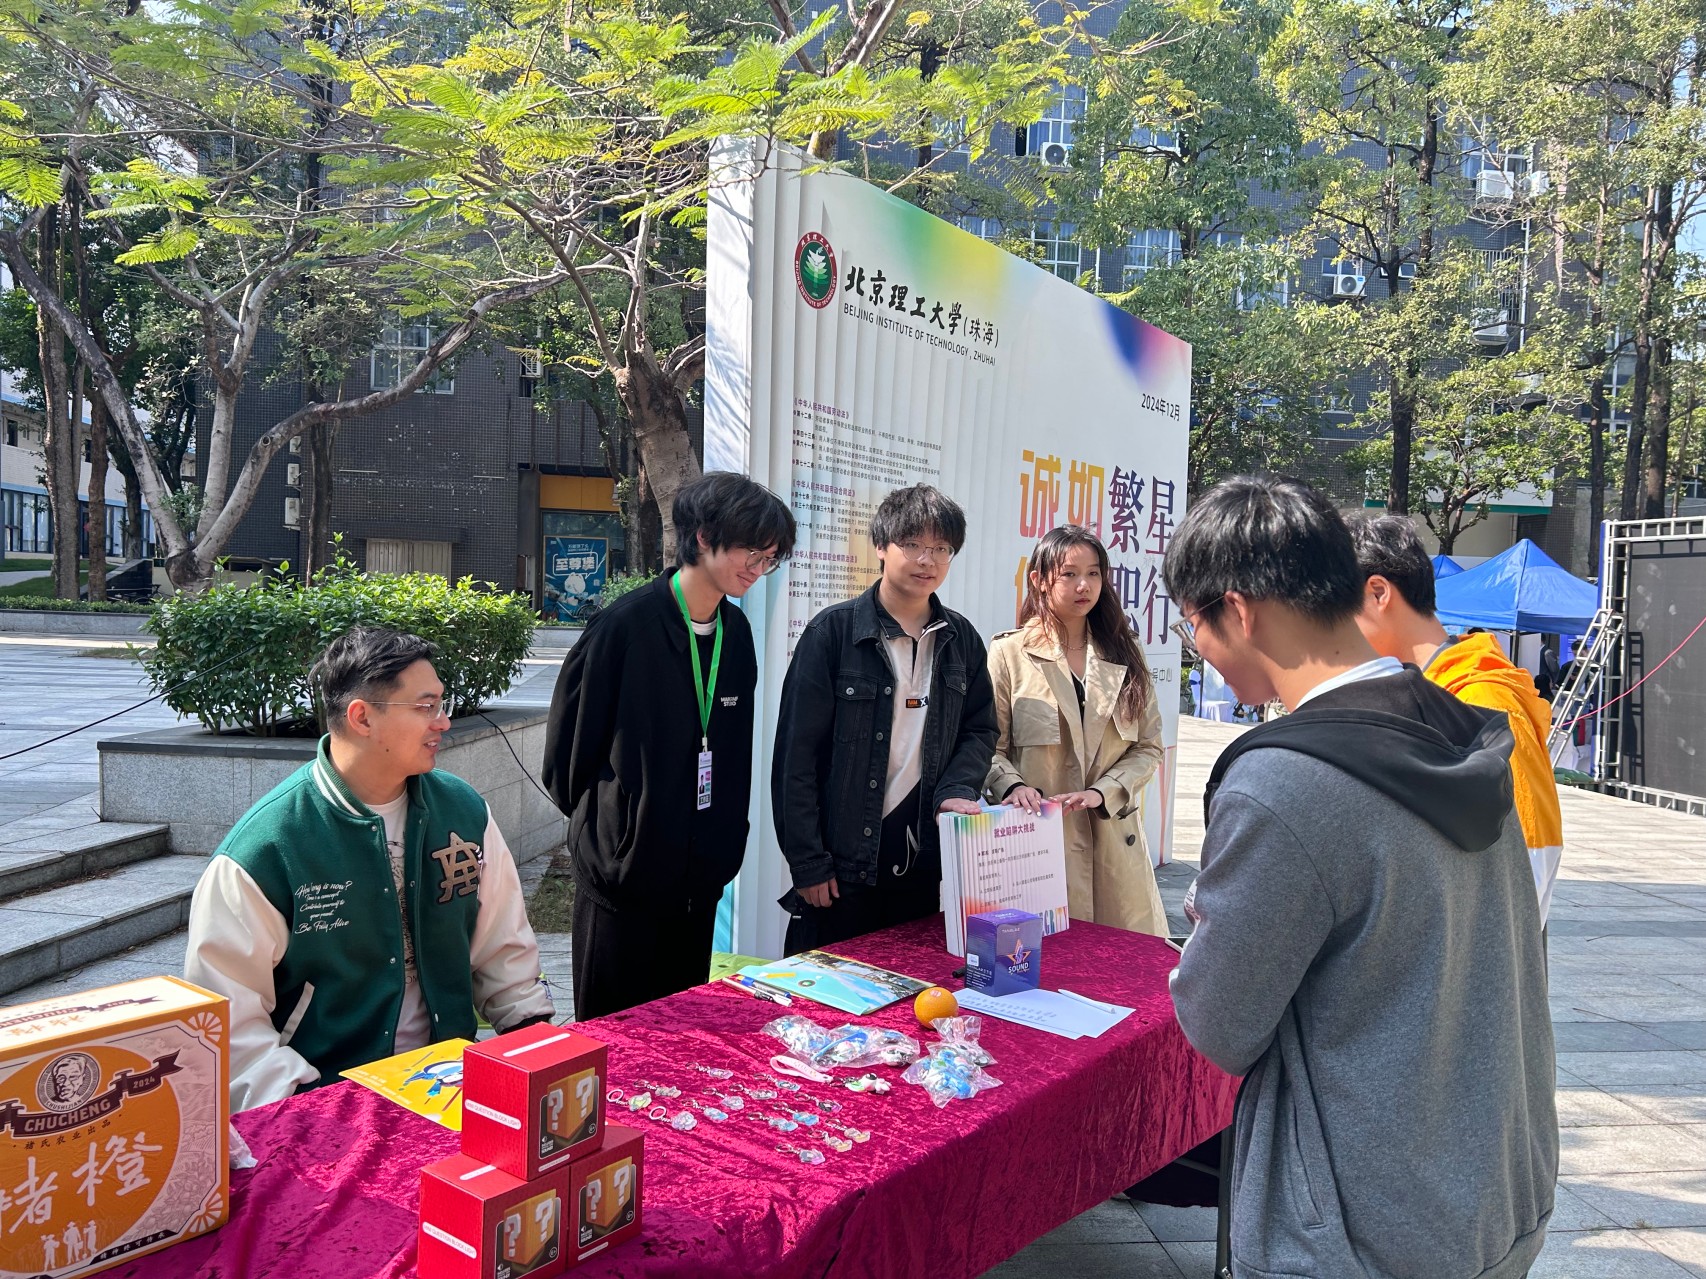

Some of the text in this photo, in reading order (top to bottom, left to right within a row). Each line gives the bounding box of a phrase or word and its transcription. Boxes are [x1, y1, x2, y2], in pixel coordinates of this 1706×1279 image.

[844, 302, 874, 324] BEIJING
[876, 312, 913, 338] INSTITUTE
[915, 328, 925, 341] OF
[973, 350, 996, 367] ZHUHAI
[793, 398, 850, 420] 《中华人民共和国劳动法》
[1141, 393, 1180, 421] 2024年12月
[793, 479, 856, 498] 《中华人民共和国劳动合同法》
[1020, 449, 1175, 556] 诚如繁星
[556, 556, 595, 571] 至尊堡
[295, 923, 312, 934] Be
[1008, 962, 1029, 974] SOUND
[133, 1075, 156, 1090] 2024
[24, 1098, 112, 1133] CHUCHENG
[474, 1105, 494, 1117] QUESTION
[494, 1113, 508, 1122] BLOCK
[507, 1119, 520, 1127] LIGHT
[24, 1119, 111, 1151] 褚氏农业出品
[0, 1131, 163, 1239] 者橙
[432, 1229, 451, 1243] QUESTION
[451, 1238, 464, 1250] BLOCK
[464, 1246, 476, 1256] LIGHT
